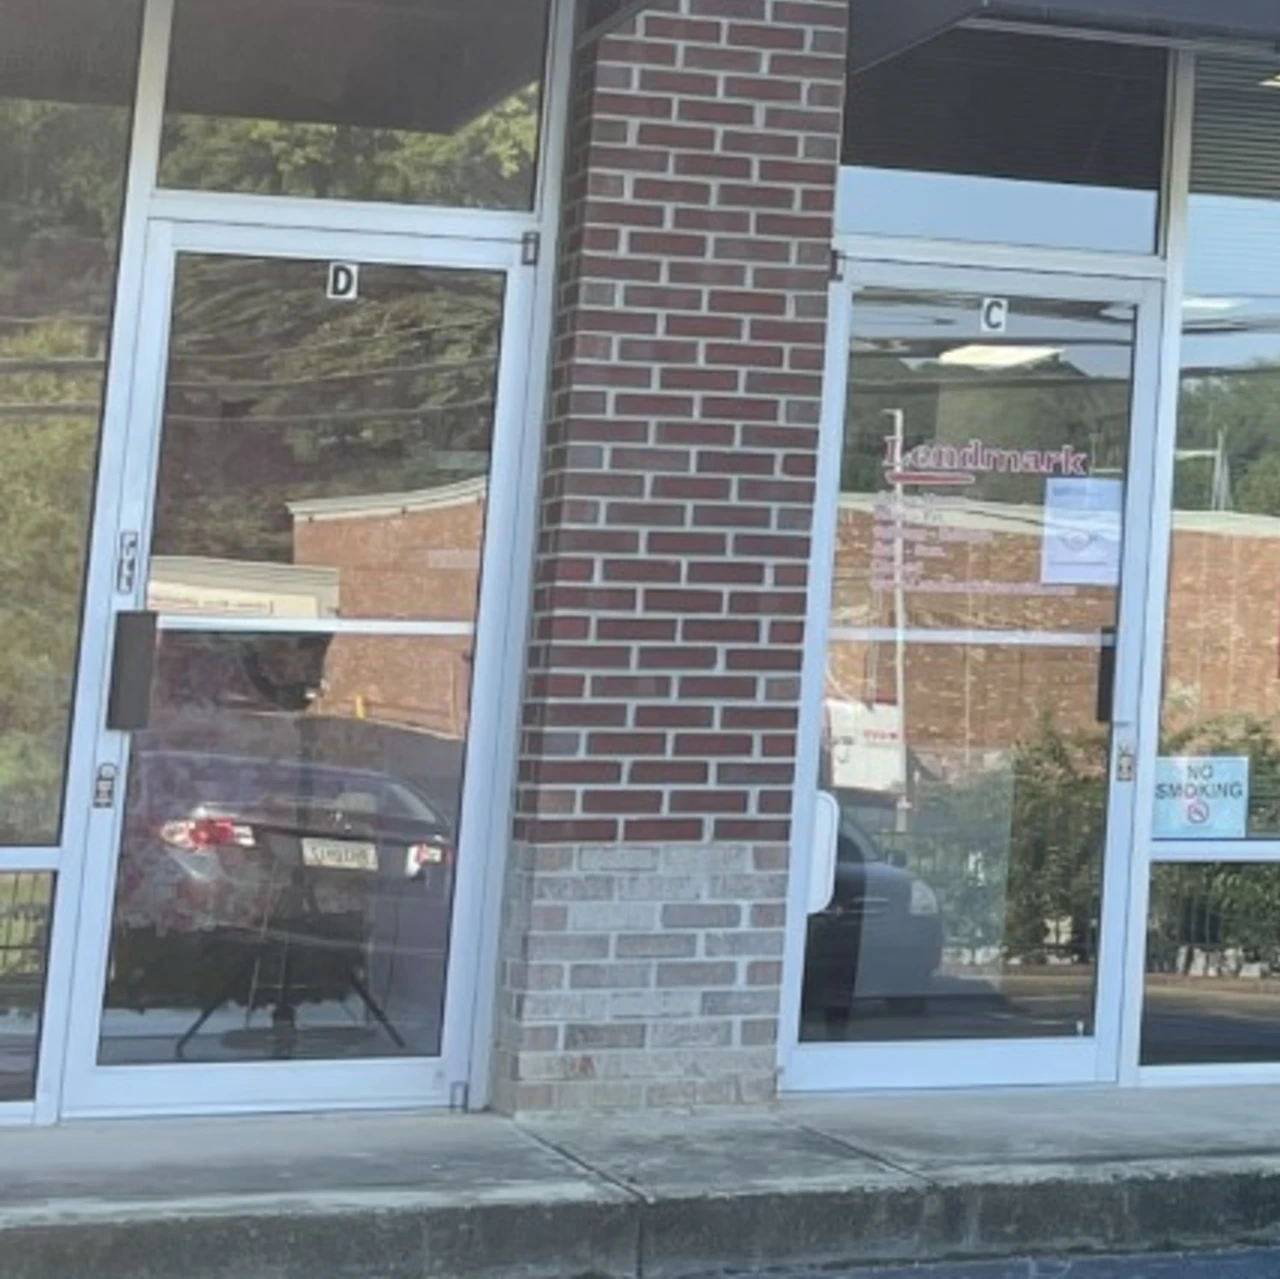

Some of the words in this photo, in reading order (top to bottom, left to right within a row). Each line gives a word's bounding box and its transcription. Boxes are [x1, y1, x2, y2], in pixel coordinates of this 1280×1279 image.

[331, 265, 354, 296] D
[983, 300, 1003, 329] C
[882, 434, 1089, 476] Lendmark
[1186, 763, 1214, 780] NO
[1154, 780, 1243, 800] SMOKING
